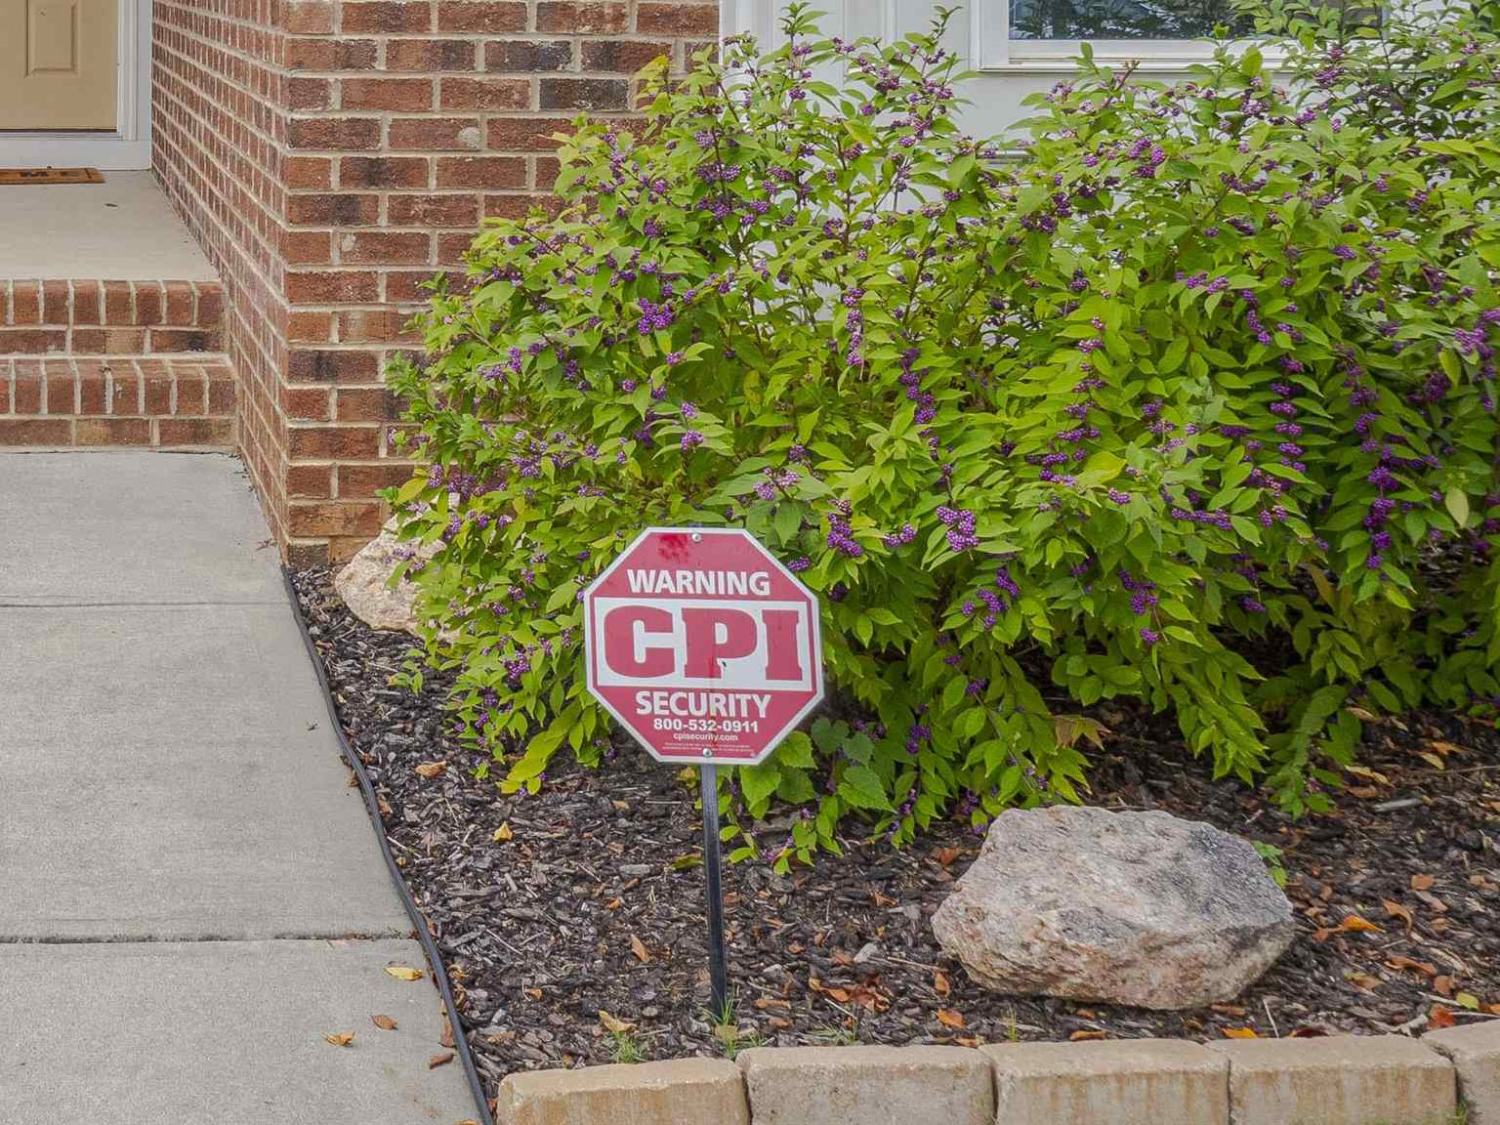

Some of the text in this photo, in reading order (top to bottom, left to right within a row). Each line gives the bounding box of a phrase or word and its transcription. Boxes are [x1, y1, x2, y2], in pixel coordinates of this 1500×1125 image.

[627, 569, 771, 596] WARNING
[603, 605, 803, 681] CPI
[635, 691, 772, 719] SECURITY
[653, 718, 759, 733] 800-532-0911
[673, 732, 739, 742] cpisecurity.com
